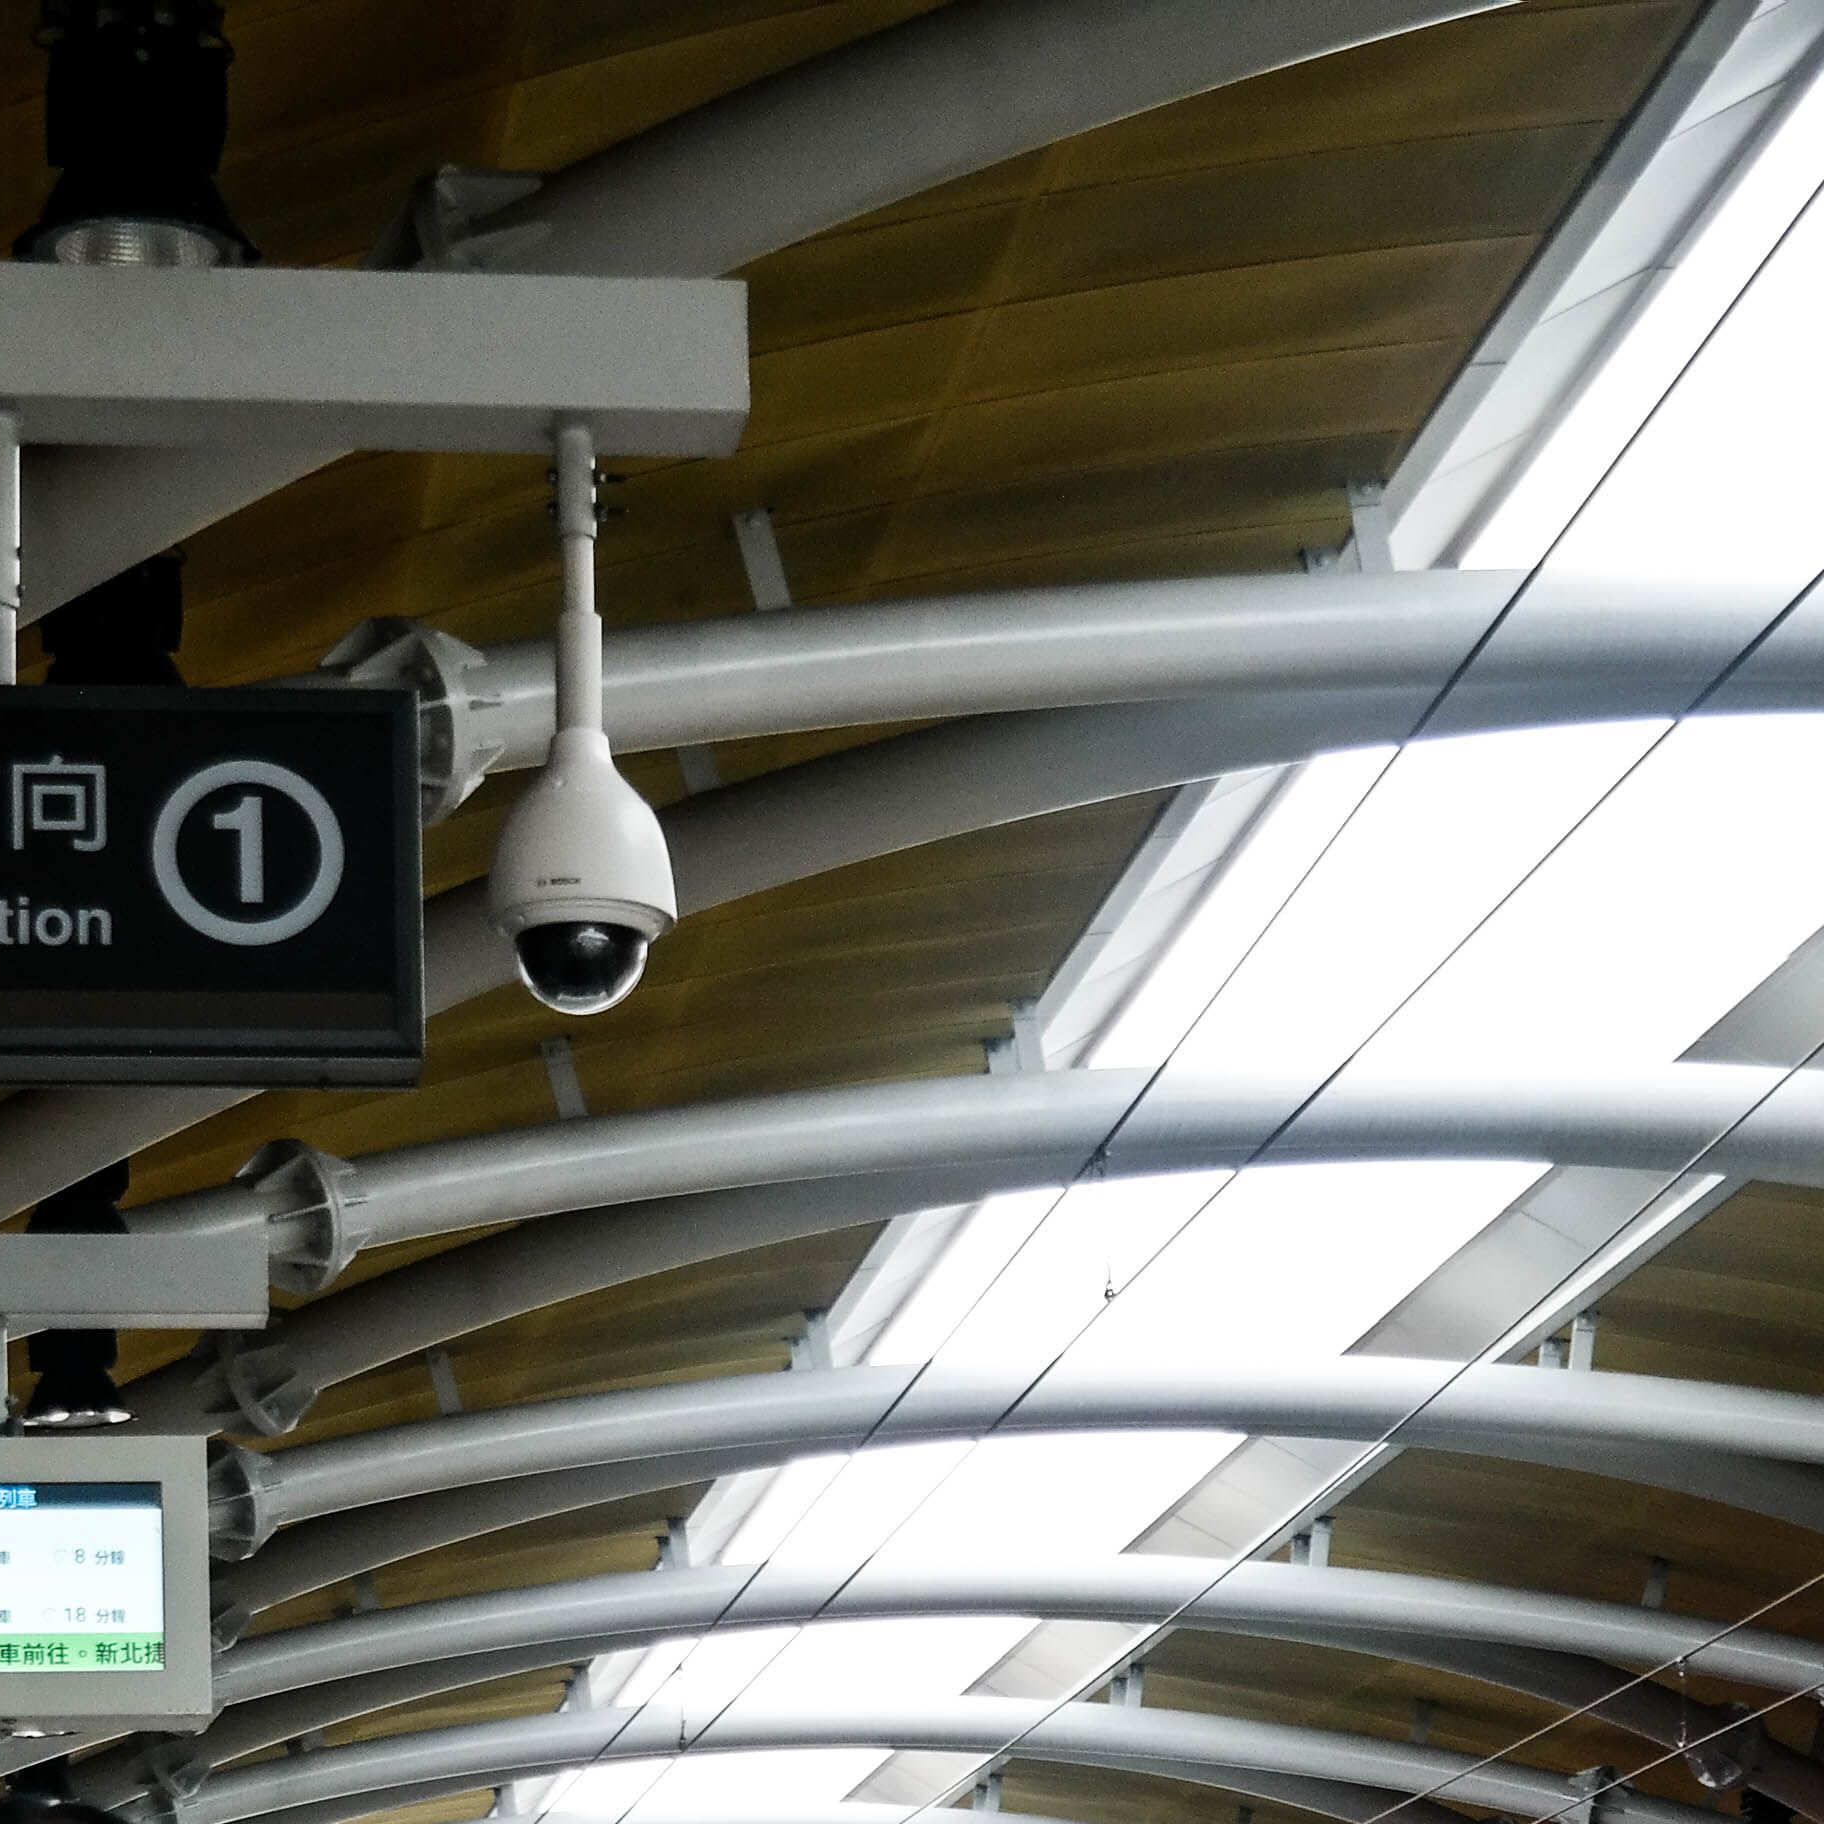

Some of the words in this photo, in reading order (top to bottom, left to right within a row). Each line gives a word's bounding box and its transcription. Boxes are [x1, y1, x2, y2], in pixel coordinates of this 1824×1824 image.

[212, 796, 265, 903] 1
[74, 1548, 86, 1565] 8
[95, 1549, 126, 1566] 分鐘
[63, 1607, 87, 1624] 18
[96, 1608, 127, 1625] 分鐘
